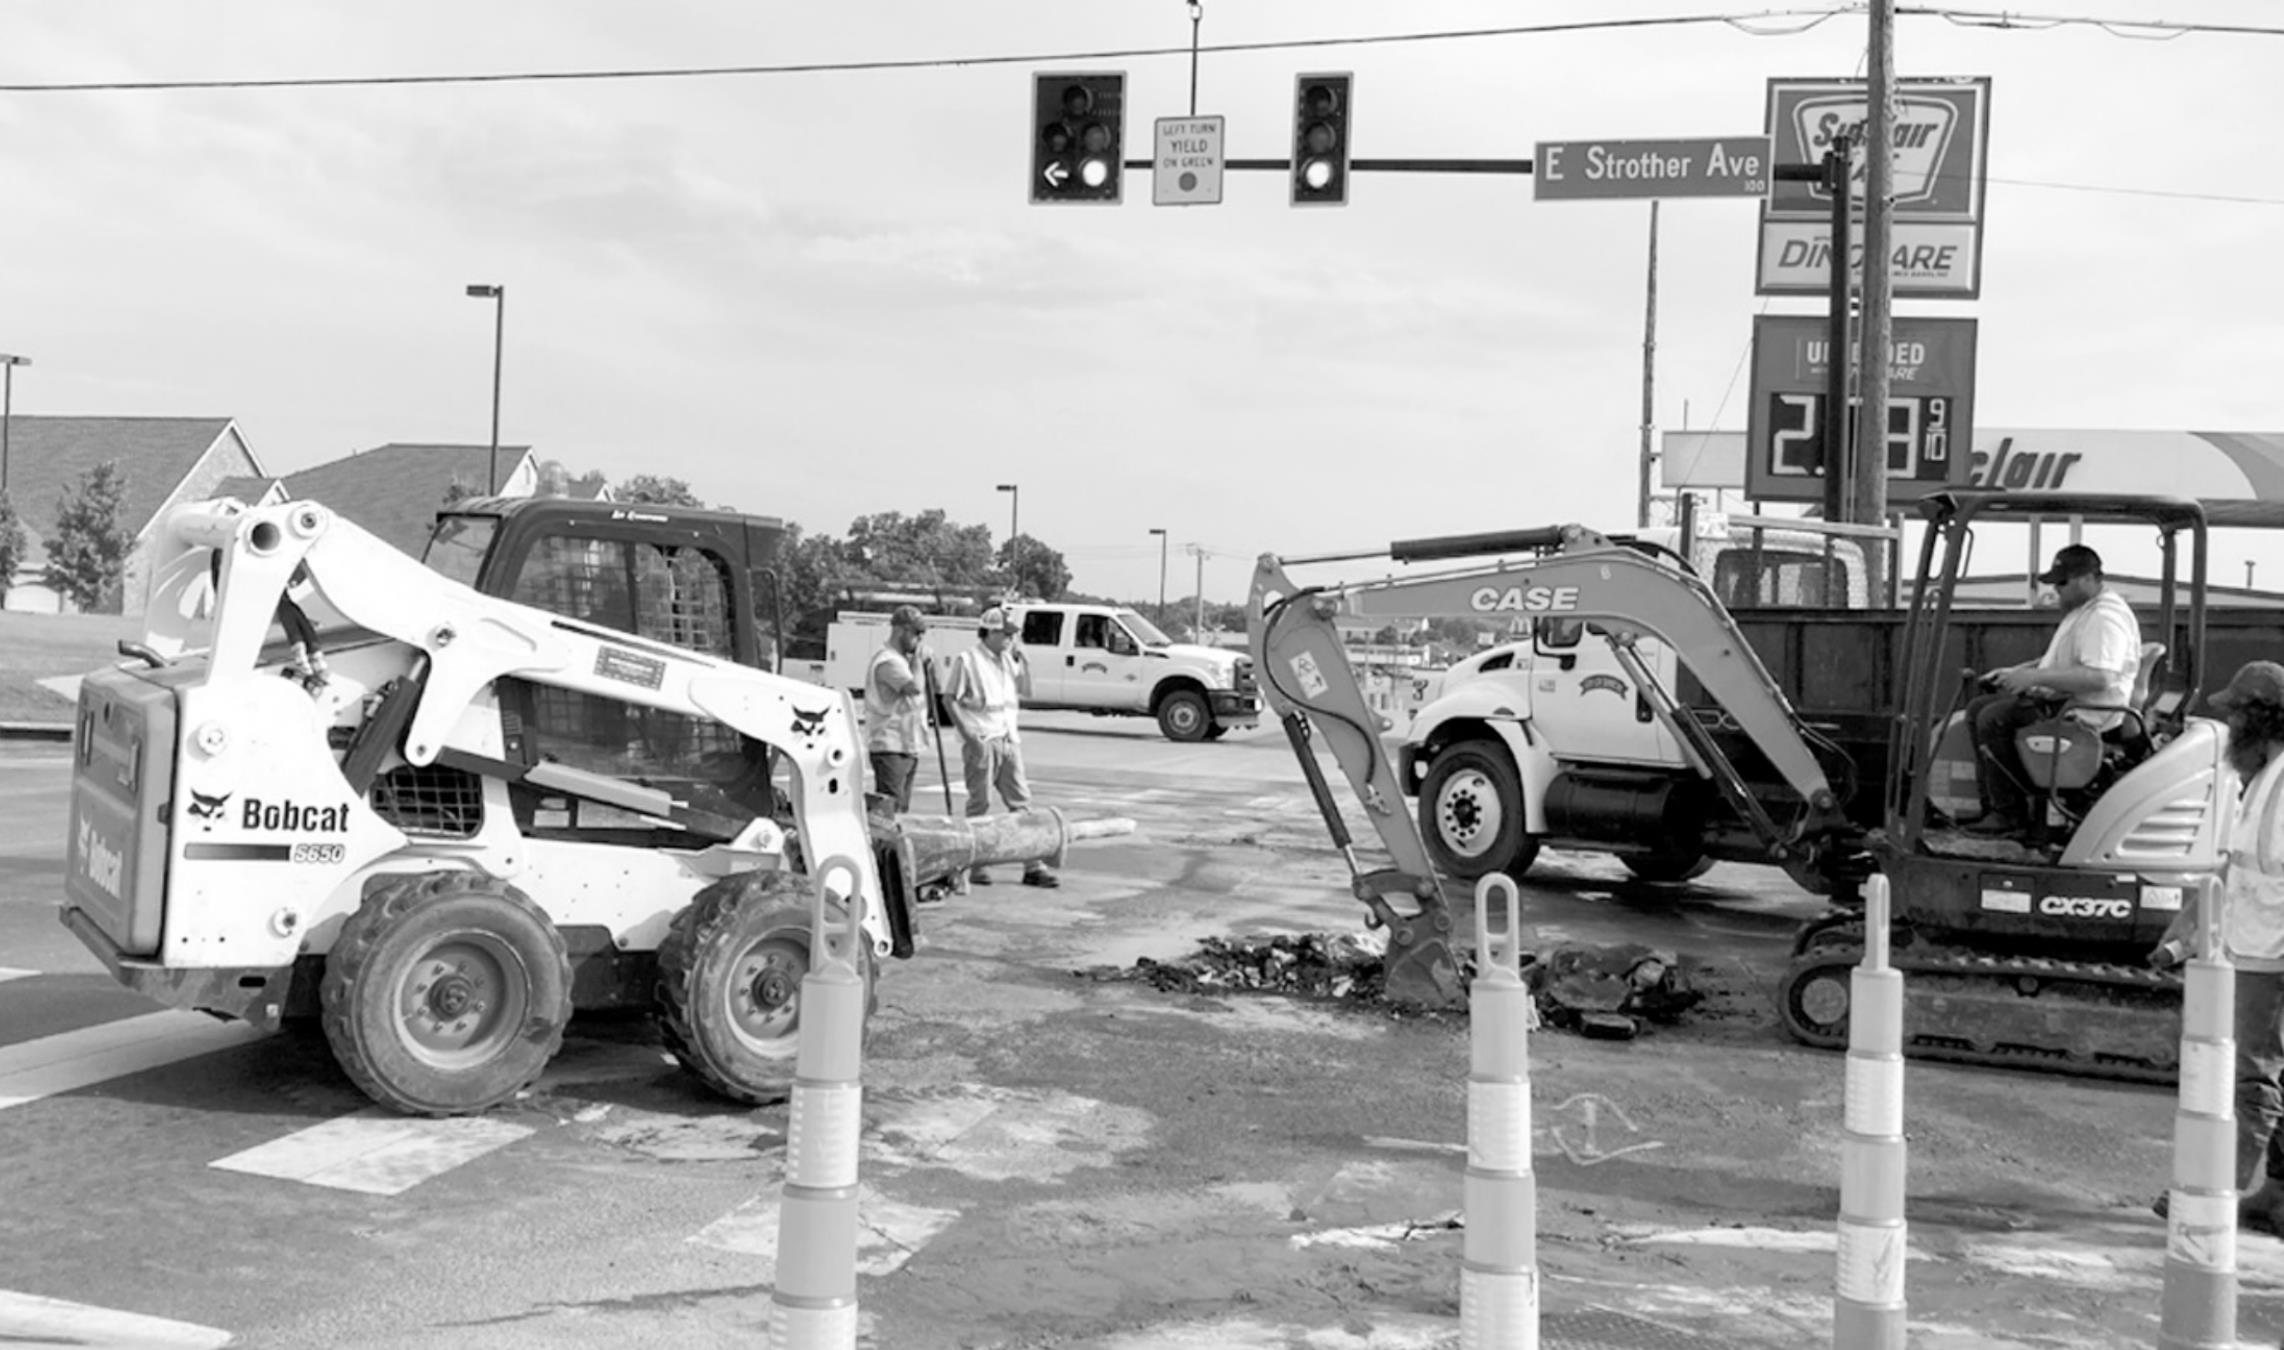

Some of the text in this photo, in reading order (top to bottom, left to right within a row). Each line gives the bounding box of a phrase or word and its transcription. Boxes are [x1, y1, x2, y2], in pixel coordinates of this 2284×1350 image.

[1163, 123, 1216, 136] LEFT TURN
[1170, 139, 1208, 153] YIELD
[1163, 157, 1213, 169] ON GREEN
[1545, 142, 1760, 181] E Strother Ave
[1929, 398, 1946, 427] 9
[1924, 432, 1946, 461] 10
[1471, 586, 1579, 612] CASE
[242, 798, 350, 833] Bobcat
[293, 842, 346, 864] S650
[2039, 896, 2133, 919] CX37C
